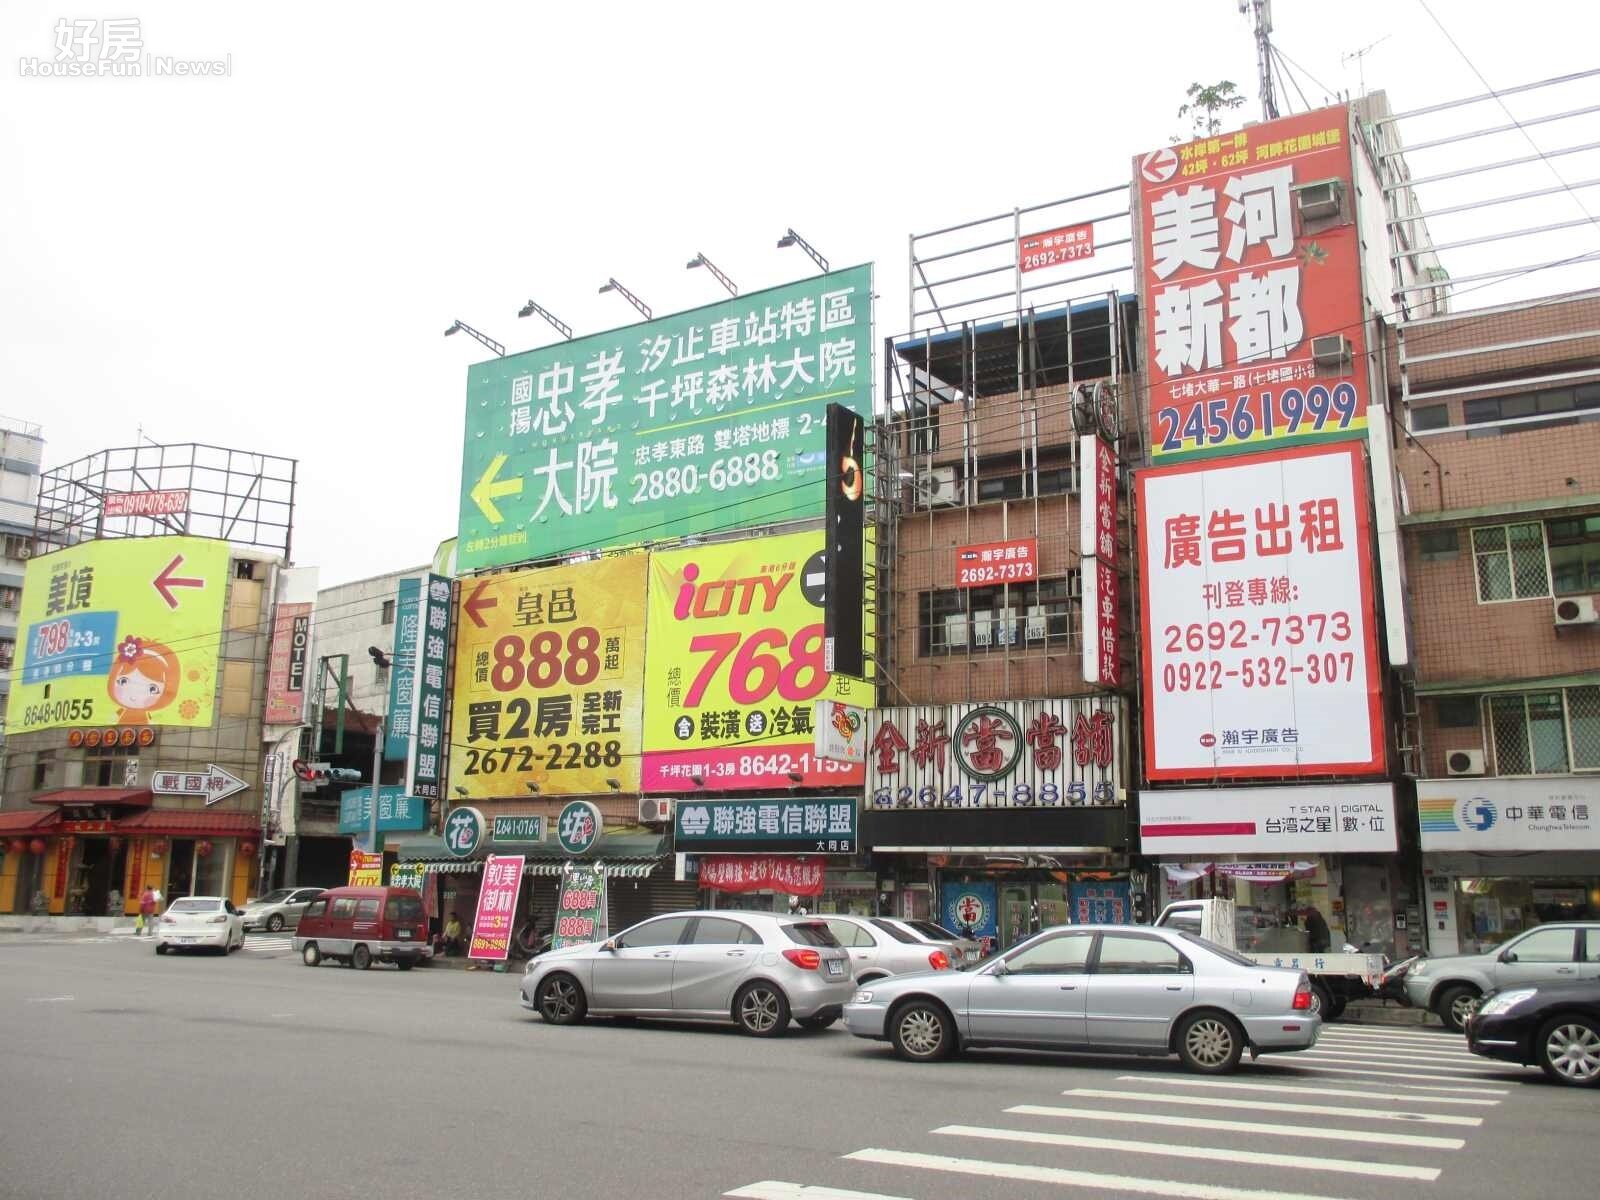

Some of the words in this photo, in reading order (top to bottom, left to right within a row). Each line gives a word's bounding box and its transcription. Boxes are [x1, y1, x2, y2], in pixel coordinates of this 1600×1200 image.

[1151, 165, 1295, 281] 美河
[1024, 243, 1092, 269] 2692-7373
[637, 287, 856, 372] 汐止車站特區
[1154, 266, 1304, 377] 新都
[533, 348, 626, 435] 忠孝
[637, 338, 857, 418] 千坪森林大院
[509, 374, 532, 437] 國揚
[1158, 382, 1358, 453] 24561999
[635, 434, 705, 466] 忠孝東路
[713, 417, 791, 453] 雙塔地標
[530, 439, 620, 523] 大院
[632, 450, 780, 504] 2880-6888
[123, 492, 188, 513] 0910-078-639
[1098, 446, 1114, 559] 全新當舖
[1164, 497, 1344, 570] 廣告出租
[46, 566, 94, 616] 美境
[961, 562, 1033, 583] 2692-7373
[1202, 576, 1299, 609] 刊登專線:
[512, 586, 578, 628] 皇邑
[1100, 566, 1117, 685] 汽車借款
[38, 619, 71, 659] 798
[1163, 611, 1353, 654] 2692-7373
[289, 618, 308, 690] MOTEL
[475, 651, 490, 683] 總價
[491, 626, 601, 693] 888
[604, 637, 620, 671] 萬起
[682, 622, 831, 708] 768
[1163, 652, 1355, 693] 0922-532-307
[417, 605, 449, 778] 聯強電信聯盟
[582, 690, 623, 713] 全新
[666, 666, 684, 709] 總價
[24, 699, 93, 727] 8648-0055
[467, 693, 574, 743] 買2房
[581, 712, 622, 737] 完工
[701, 711, 741, 740] 裝潢
[871, 718, 950, 775] 全新
[962, 713, 1014, 772] 當
[1026, 708, 1116, 771] 當舖
[1222, 727, 1299, 745] 瀚宇廣告
[464, 740, 622, 776] 2672-2288
[659, 762, 736, 777] 千坪花園1-3房
[414, 784, 438, 796] 大同店
[1289, 806, 1297, 814] T
[1300, 805, 1331, 814] STAR
[1341, 804, 1384, 813] DIGITAL
[451, 815, 474, 849] 花
[495, 818, 540, 835] 2641-0769
[561, 808, 594, 845] 坊
[712, 804, 852, 835] 聯強電信聯盟
[1505, 805, 1589, 821] 中華電信
[816, 840, 849, 851] 大同店
[487, 864, 518, 887] 敦美
[483, 889, 514, 913] 御林
[958, 897, 981, 923] 當
